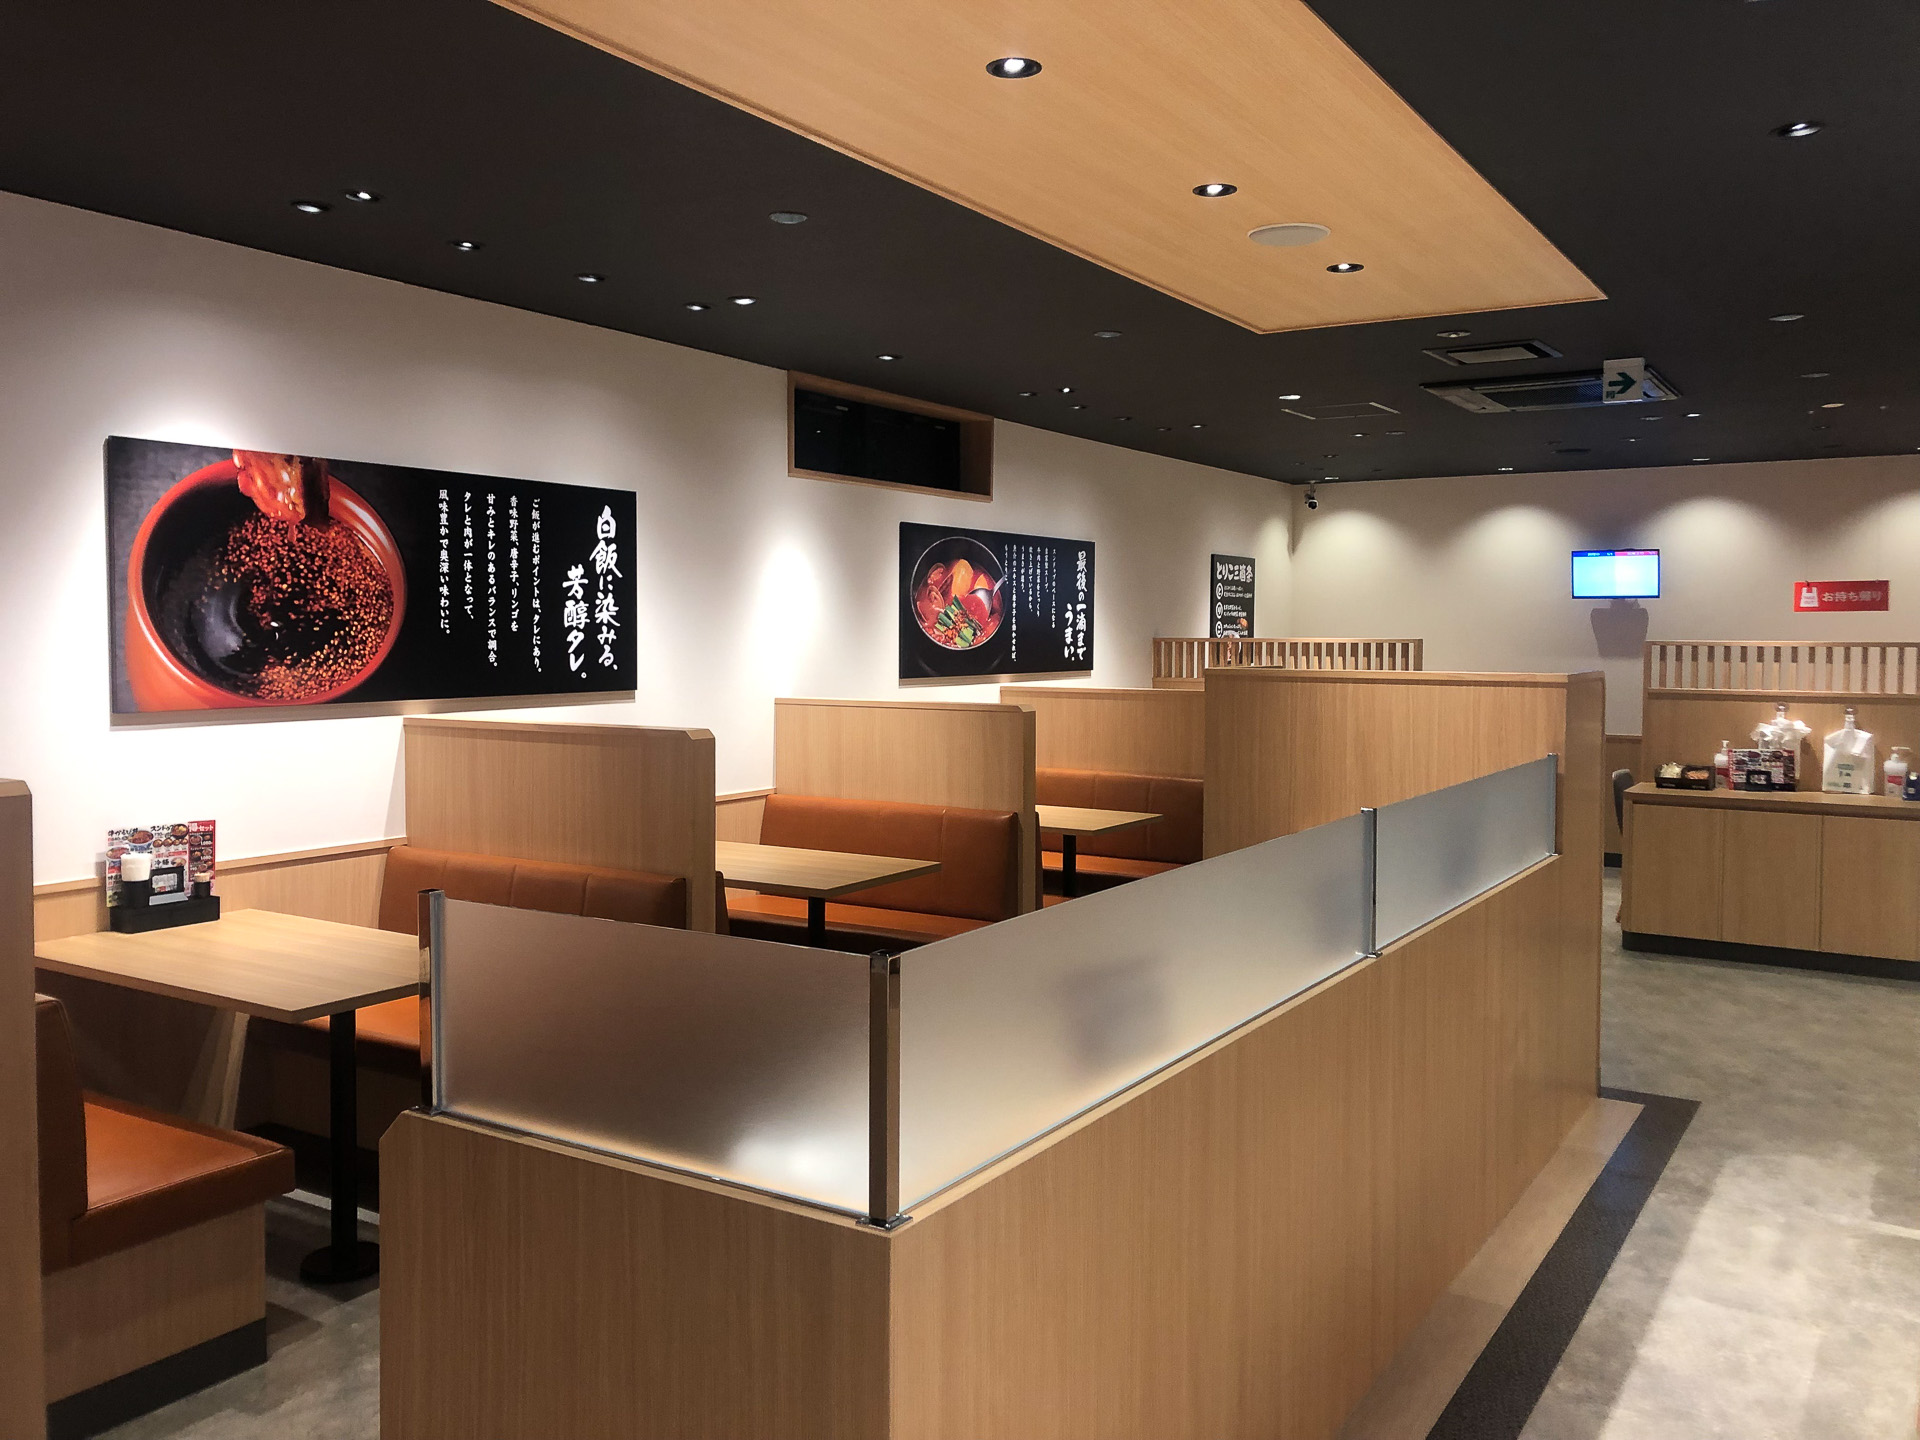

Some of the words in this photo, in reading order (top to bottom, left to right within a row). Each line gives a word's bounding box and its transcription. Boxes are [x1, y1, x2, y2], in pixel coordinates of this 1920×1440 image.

[438, 489, 450, 634] 風味豊かで奥深い味わいに。
[463, 491, 474, 620] タレと肉が一体となって、
[486, 493, 498, 667] 甘みとキレのあるバランスで調合。
[508, 495, 519, 632] 香味野菜、唐辛子、リンゴを
[531, 498, 542, 672] ご飯が進むポイントは、タレにあり。
[562, 564, 590, 679] 芳醇タレ。
[589, 504, 623, 671] 白飯に染みる、
[1075, 550, 1087, 661] 最後の一滴まで
[1821, 590, 1883, 602] お持ち帰り
[1063, 603, 1075, 661] うまい。
